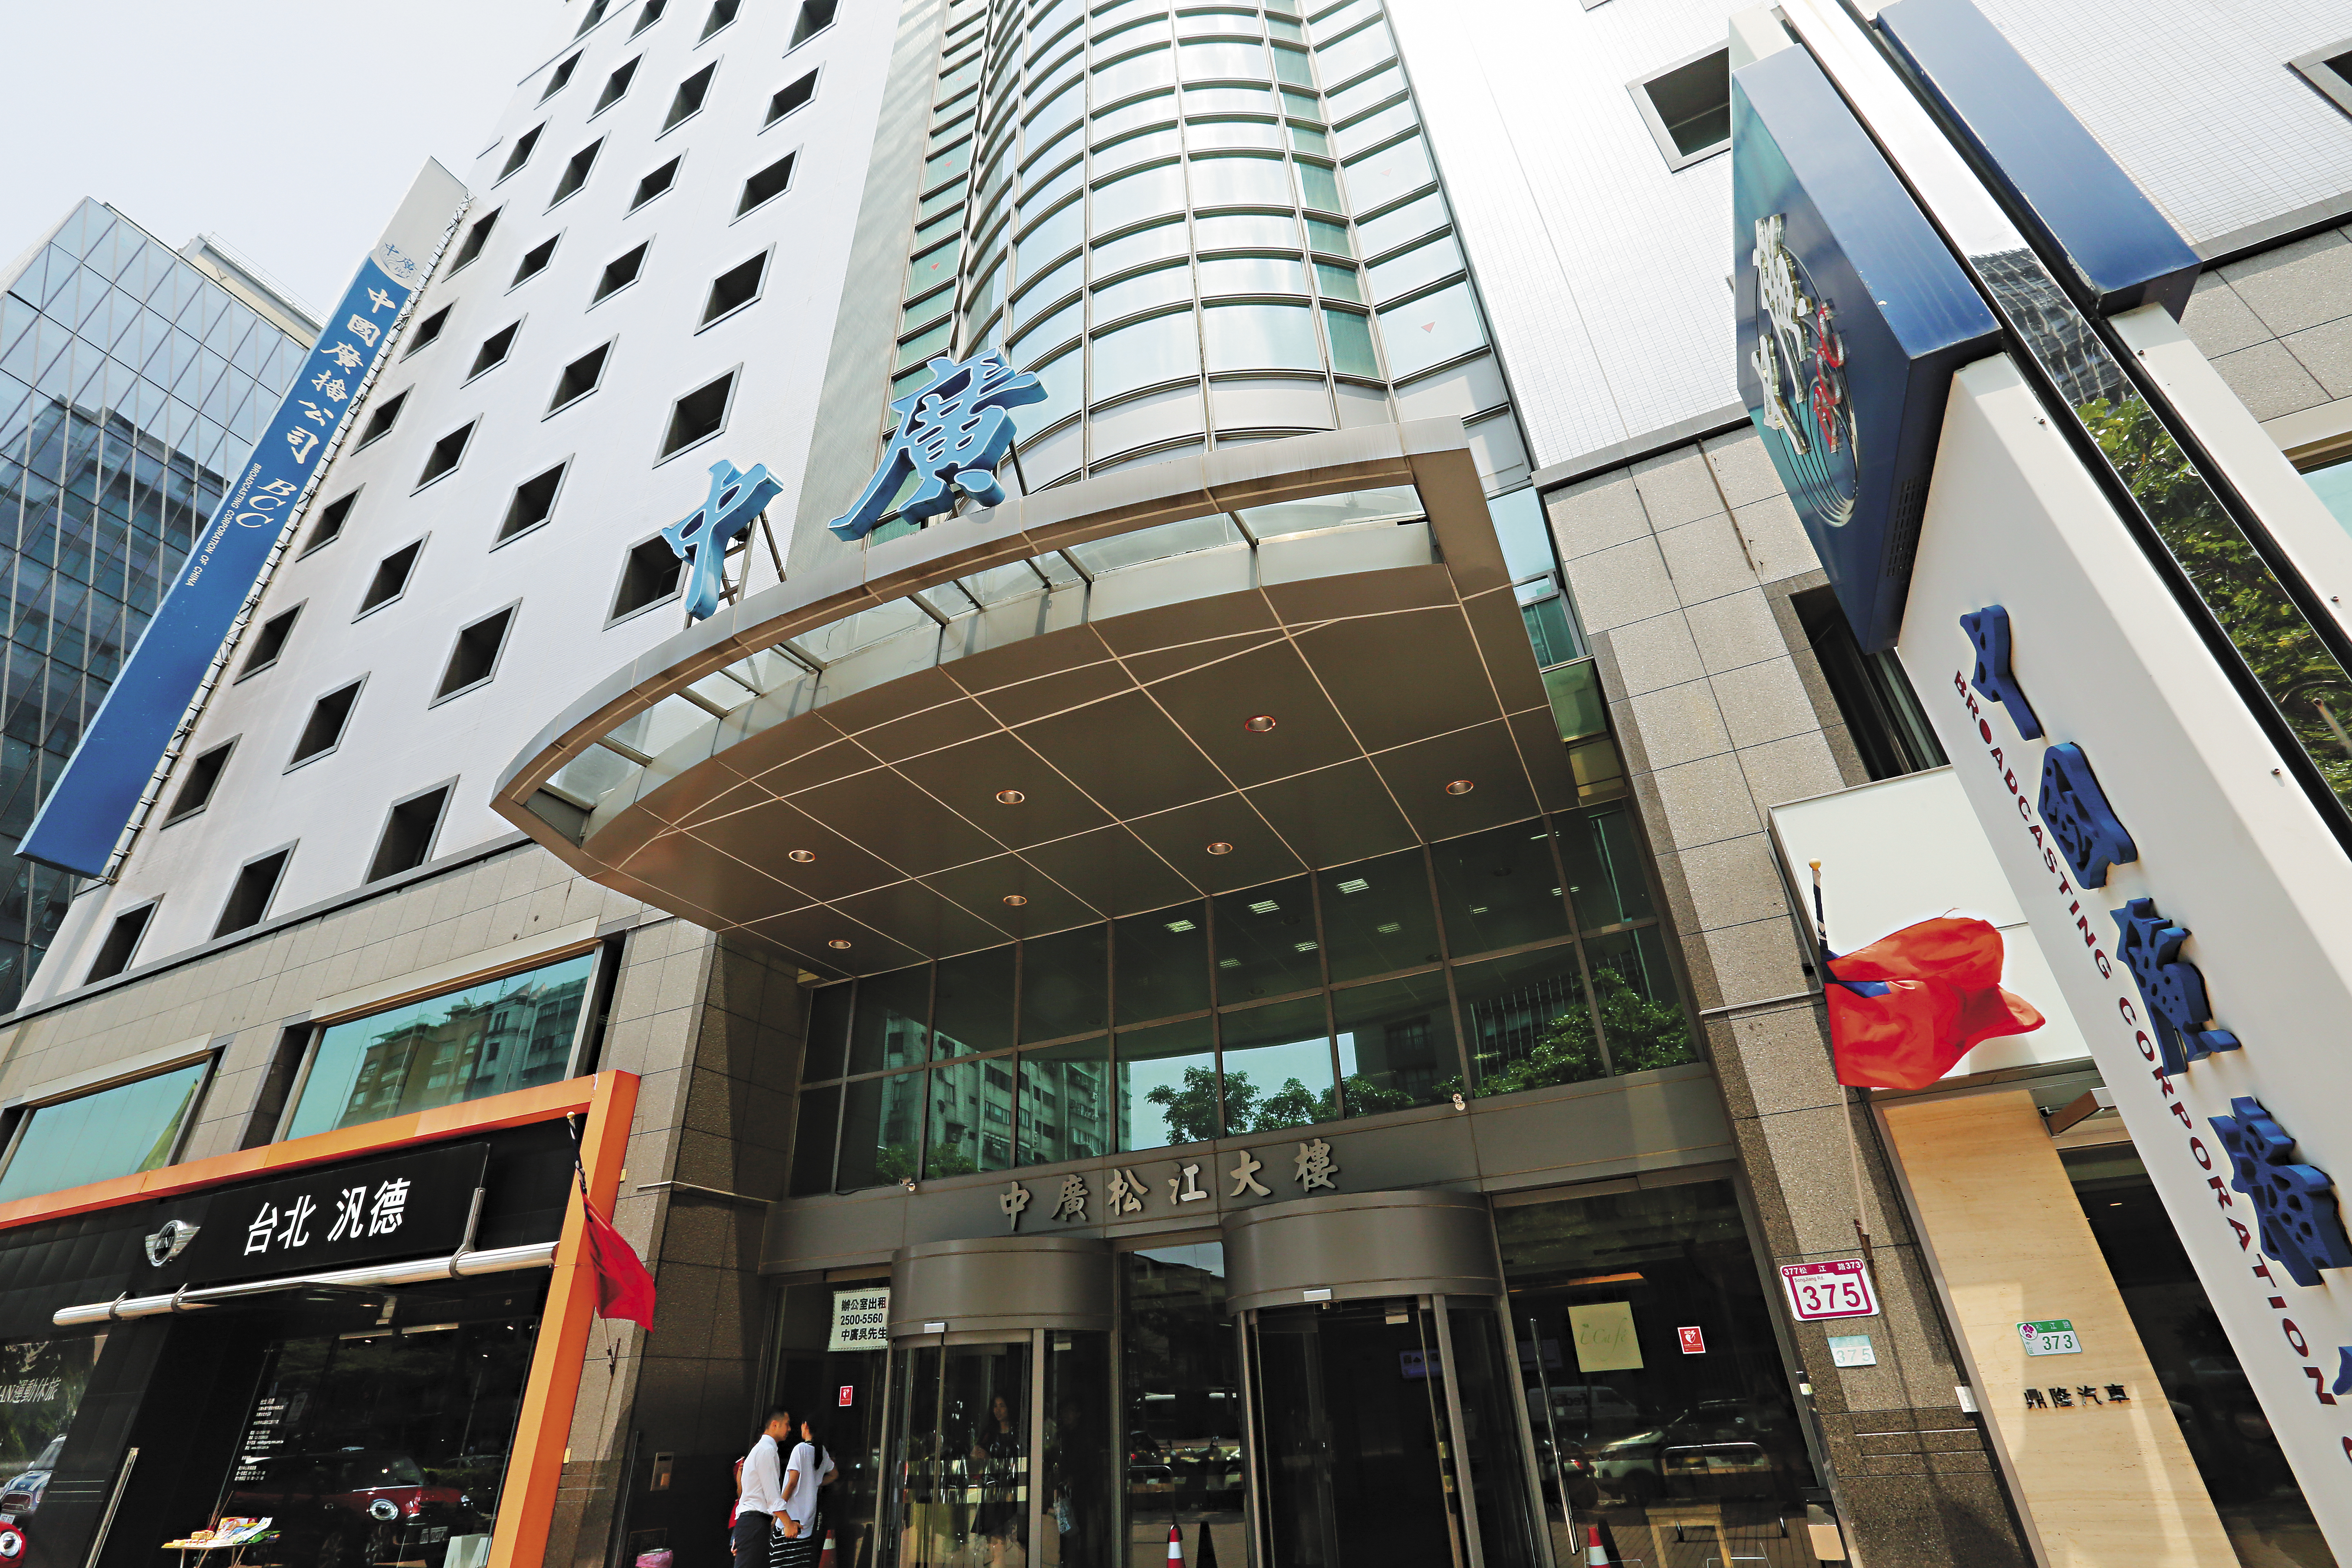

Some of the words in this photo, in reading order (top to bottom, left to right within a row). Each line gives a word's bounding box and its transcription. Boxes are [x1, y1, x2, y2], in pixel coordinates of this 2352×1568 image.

[385, 243, 417, 270] 中廣
[1752, 214, 1815, 455] 中廣
[287, 287, 395, 464] 中國廣播公司
[1813, 299, 1845, 453] BCC
[231, 463, 262, 509] BROADCASTING
[660, 347, 1048, 621] 中廣
[235, 478, 297, 528] BCC
[205, 510, 235, 554] CORPORATION
[199, 555, 209, 566] OF
[185, 566, 203, 587] CHINA
[1960, 604, 2352, 1396] 中國廣播
[1953, 670, 2113, 980] BROADCASTING
[2118, 996, 2338, 1406] CORPORATION
[999, 1138, 1339, 1231] 中廣松江大樓
[244, 1195, 316, 1256] 台北
[327, 1178, 411, 1242] 汎德
[1799, 1263, 1846, 1274] 松江路
[1845, 1261, 1862, 1270] 373
[841, 1297, 886, 1312] 辦公室出租
[1803, 1282, 1861, 1311] 375
[840, 1313, 883, 1325] 2500-5560
[2035, 1321, 2071, 1330] 松江路
[841, 1327, 886, 1341] 中廣吳先生
[2042, 1334, 2073, 1350] 373
[1836, 1348, 1871, 1363] 375
[2024, 1383, 2130, 1409] 鼎隆汽車
